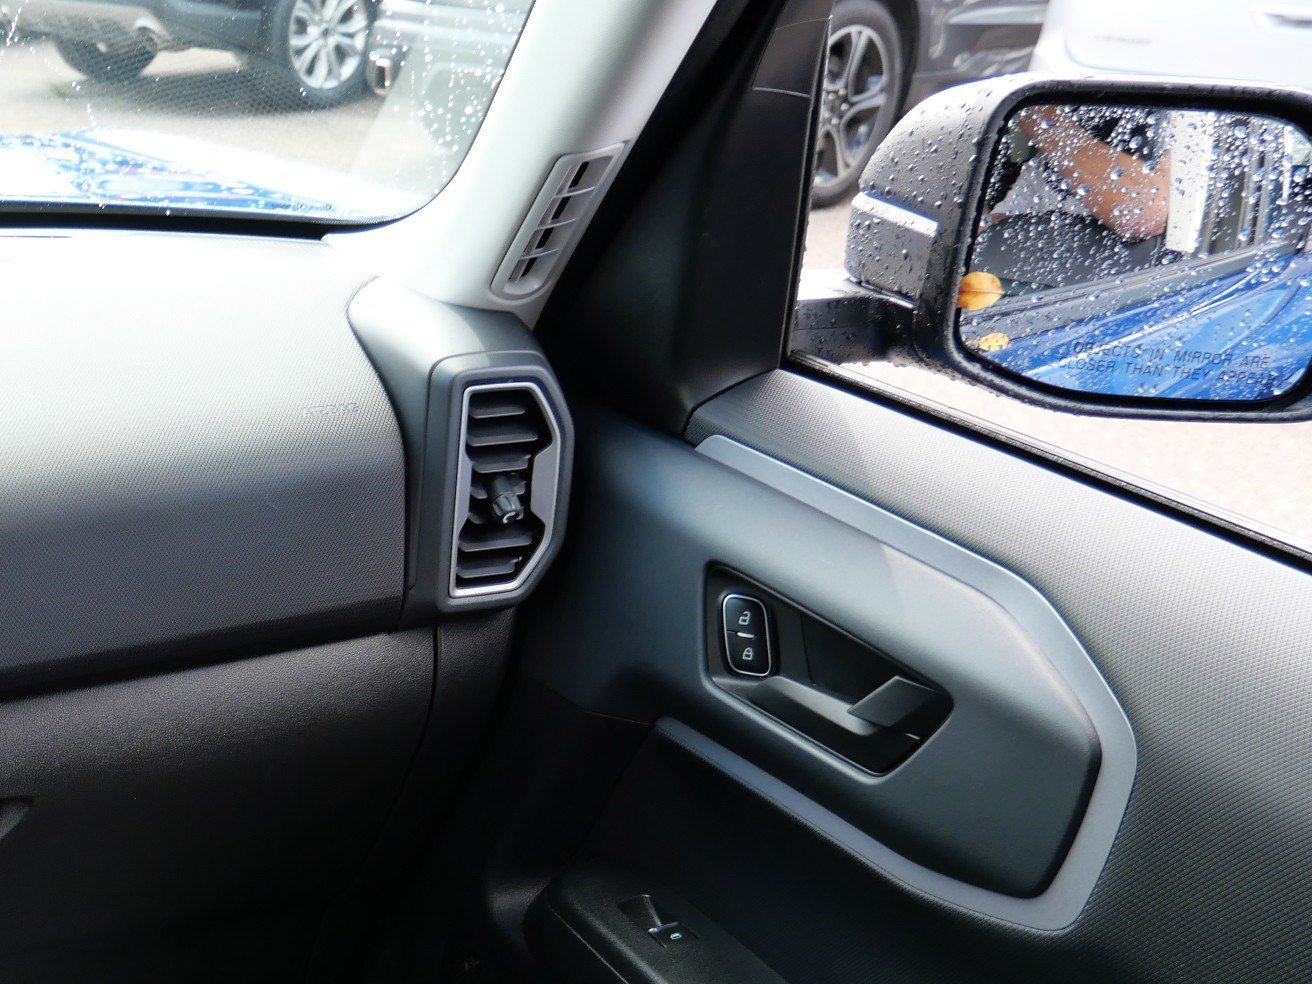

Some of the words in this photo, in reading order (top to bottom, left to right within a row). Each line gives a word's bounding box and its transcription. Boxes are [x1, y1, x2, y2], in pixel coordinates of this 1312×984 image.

[1149, 348, 1166, 361] IN
[1173, 350, 1233, 365] MIRROR
[1239, 355, 1271, 368] ARE
[1125, 362, 1164, 377] THAN
[1173, 366, 1213, 380] THEY
